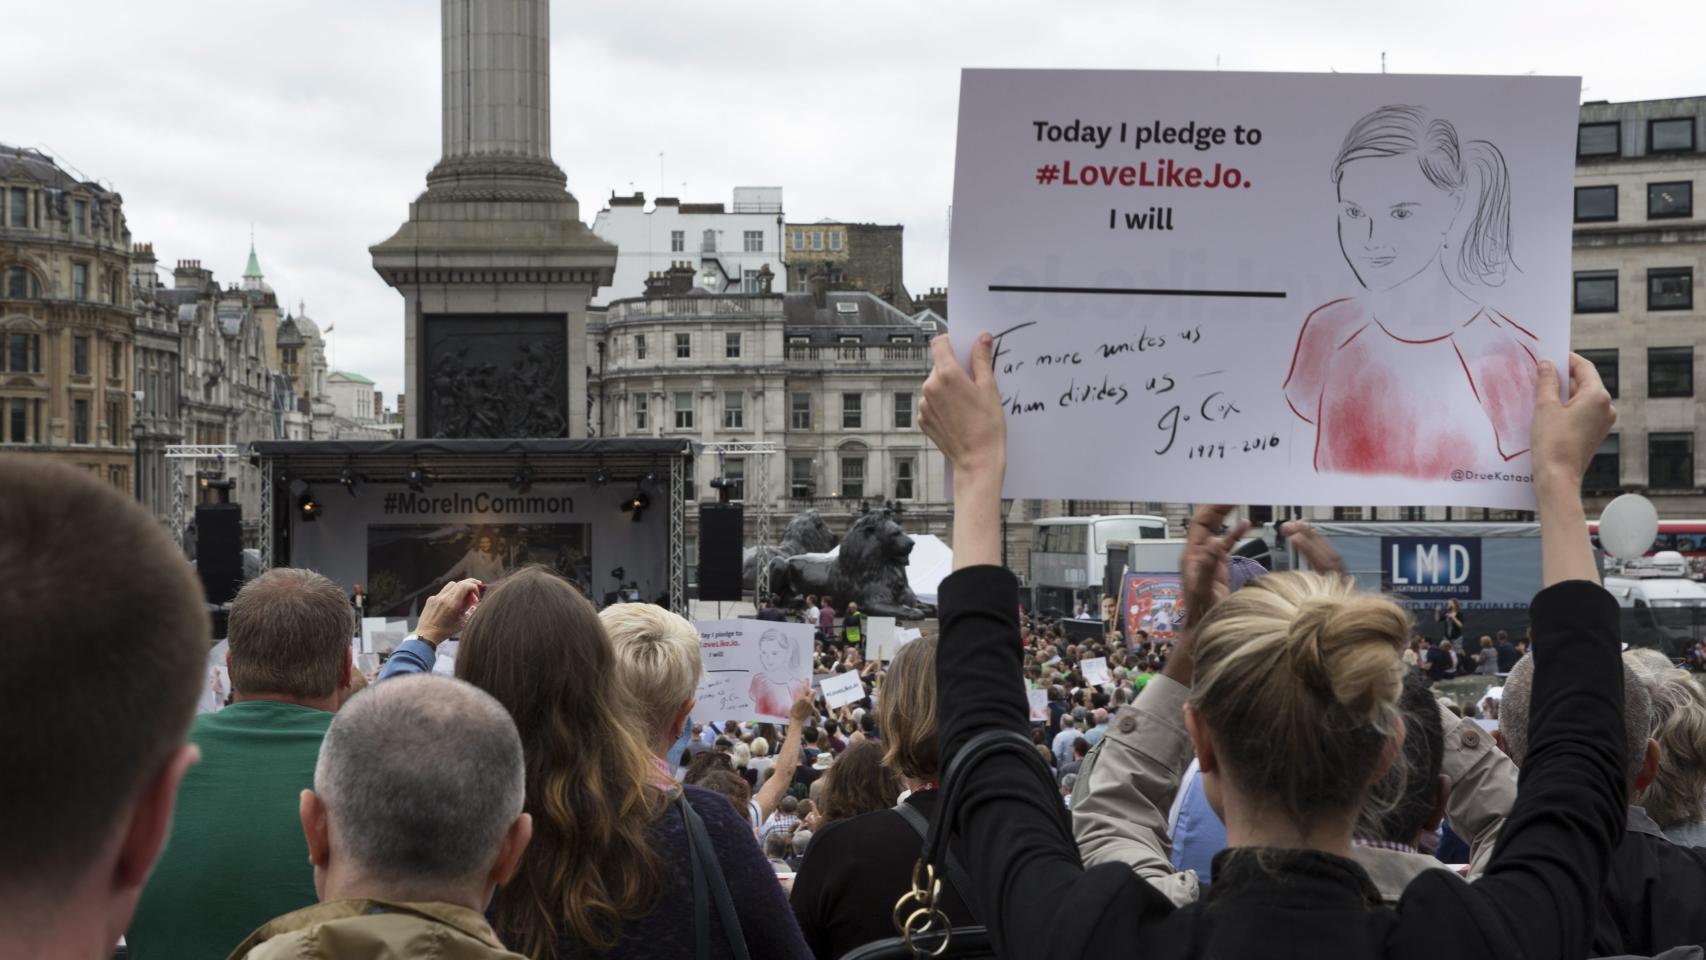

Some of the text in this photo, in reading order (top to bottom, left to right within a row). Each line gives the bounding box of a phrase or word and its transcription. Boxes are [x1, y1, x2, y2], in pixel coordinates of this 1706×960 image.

[1033, 119, 1262, 151] Today I pledge to
[1036, 159, 1251, 189] #LoveLikeJo.
[1110, 206, 1173, 230] I will
[992, 321, 1202, 374] Far more unites us
[1059, 375, 1128, 405] divides
[1146, 373, 1175, 395] us
[1201, 392, 1240, 421] Cox
[384, 492, 573, 514] #MoreInCommon
[1392, 544, 1470, 584] LMD
